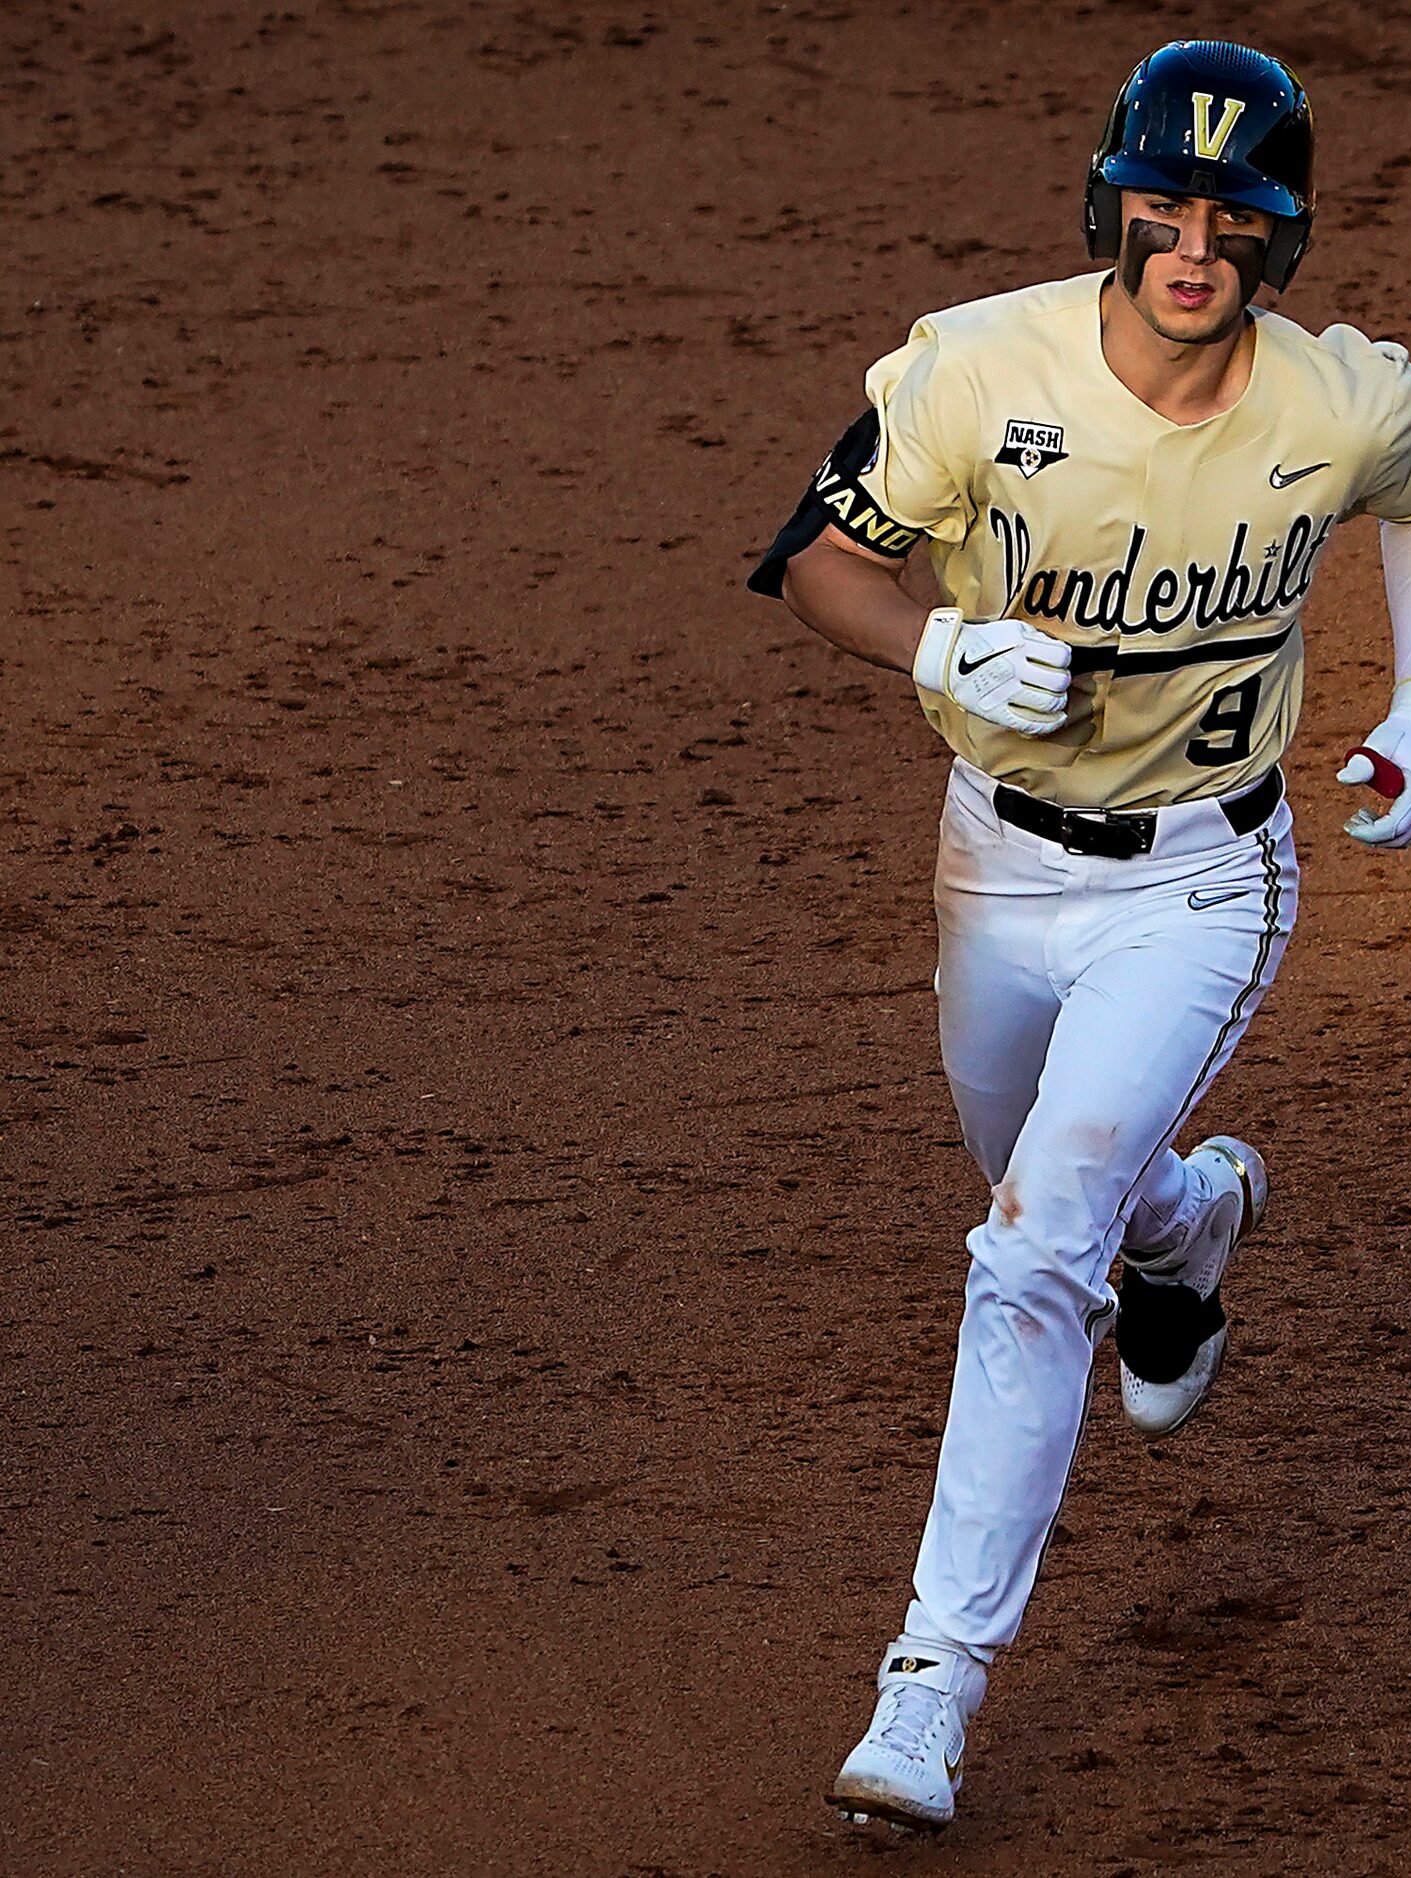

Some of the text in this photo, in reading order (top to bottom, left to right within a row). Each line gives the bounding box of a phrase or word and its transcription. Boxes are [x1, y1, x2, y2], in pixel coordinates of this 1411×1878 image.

[1192, 92, 1246, 161] V
[1009, 426, 1060, 449] NASH
[988, 506, 1337, 636] Vanderbilt
[1184, 672, 1263, 767] 9
